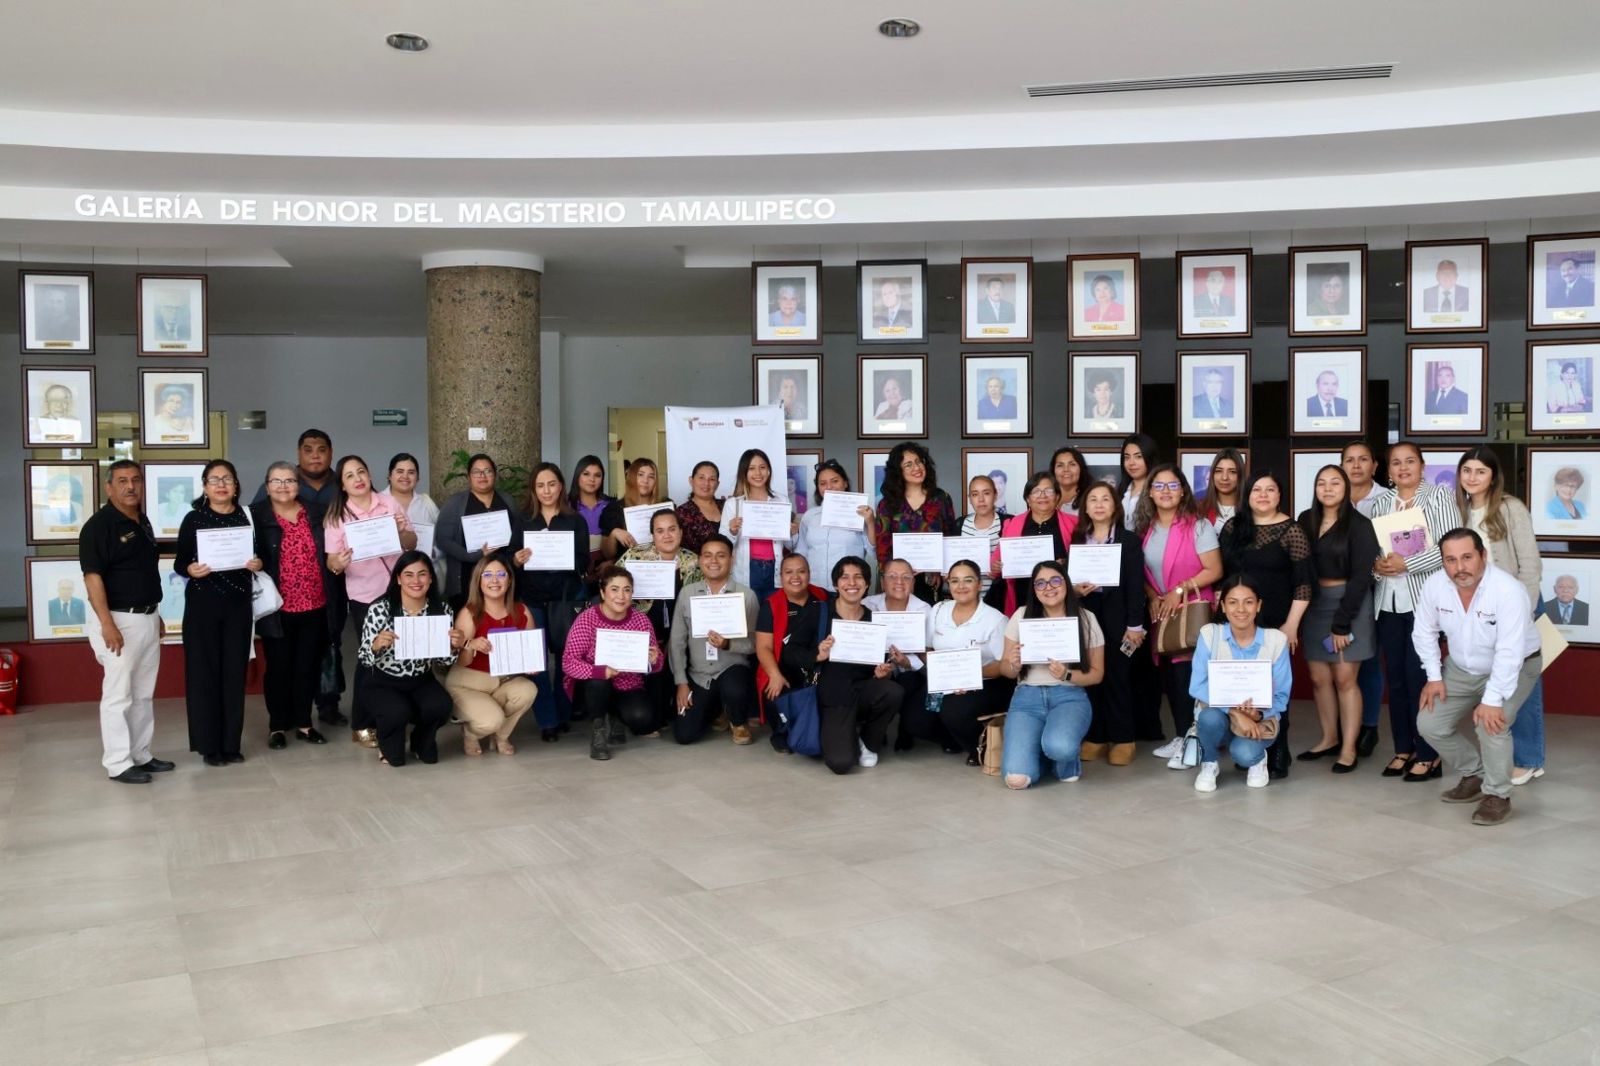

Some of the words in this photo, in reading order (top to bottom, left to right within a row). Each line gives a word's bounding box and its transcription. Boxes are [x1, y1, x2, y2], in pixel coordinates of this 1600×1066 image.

[75, 193, 204, 220] GALERÍA
[220, 199, 257, 221] DE
[273, 201, 378, 222] HONOR
[393, 203, 443, 223] DEL
[458, 202, 626, 223] MAGISTERIO
[641, 198, 836, 223] TAMAULIPECO
